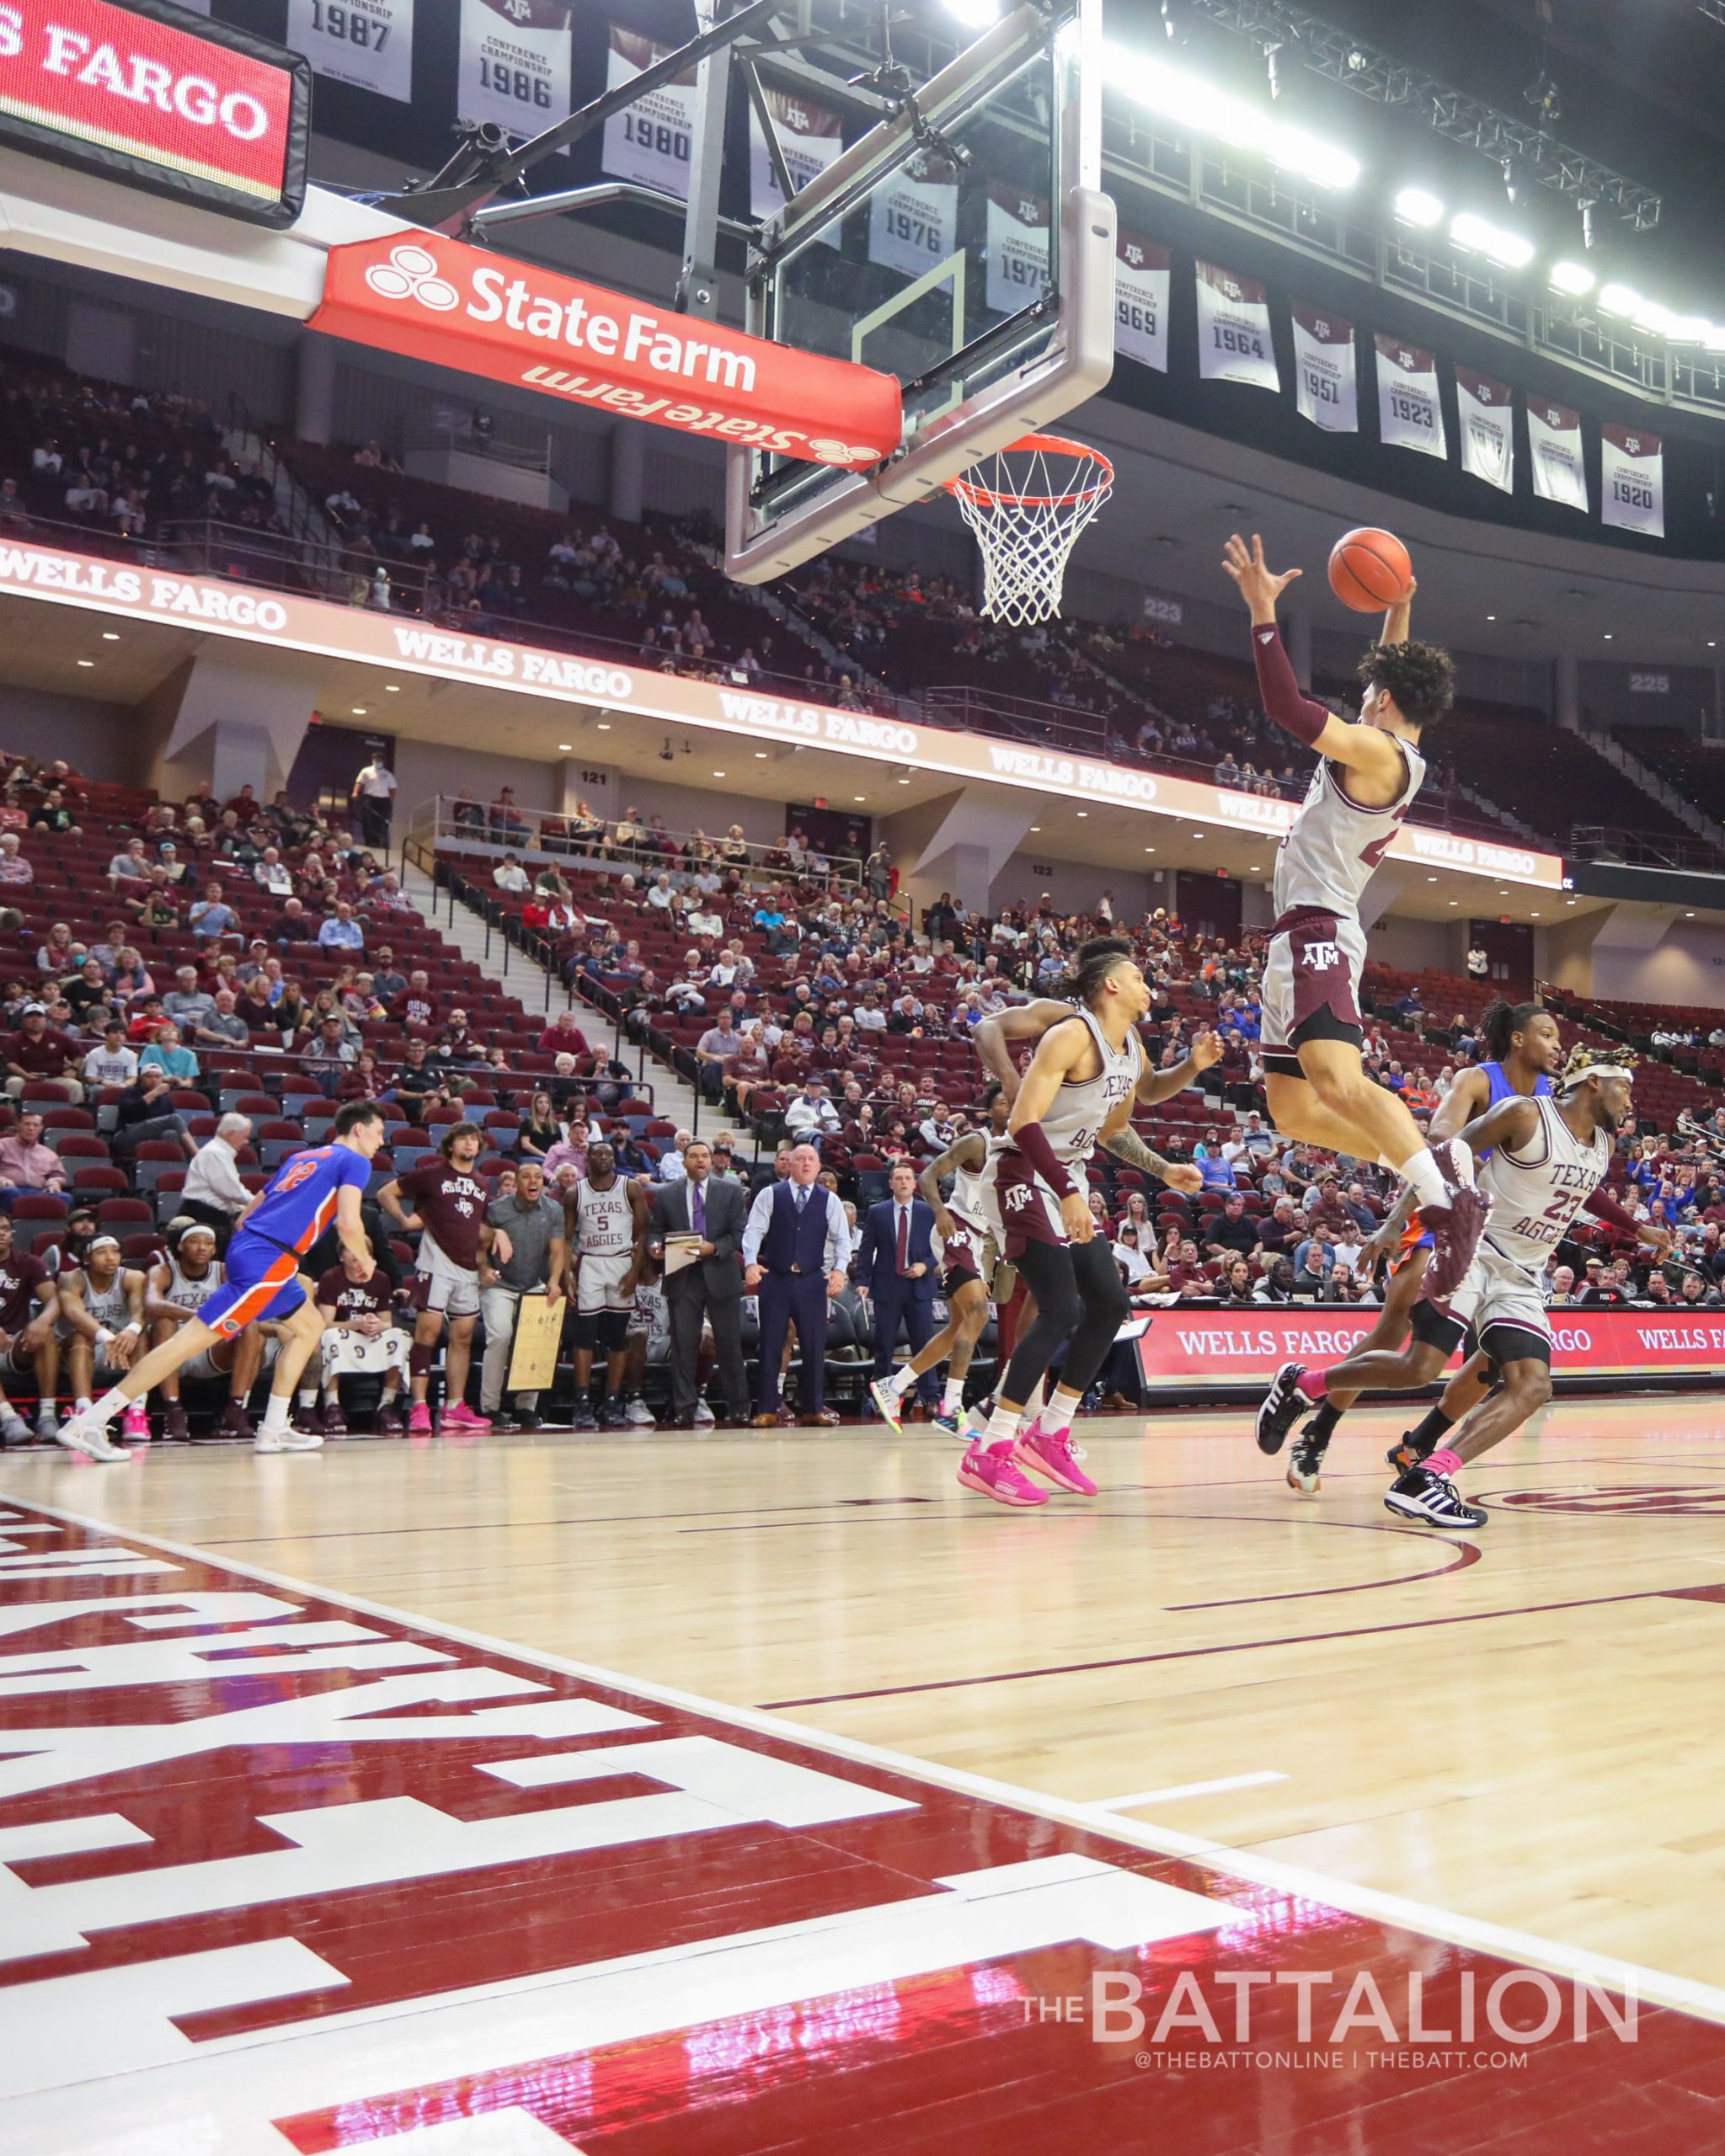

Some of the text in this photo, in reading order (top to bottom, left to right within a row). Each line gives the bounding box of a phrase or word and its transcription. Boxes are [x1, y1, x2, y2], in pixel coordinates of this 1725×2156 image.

[312, 0, 391, 52] 1987
[481, 44, 553, 76] CHAMPIONSHIP
[487, 35, 547, 65] CONFERENCE
[41, 23, 268, 141] FARGO
[480, 56, 553, 109] 1986
[625, 113, 689, 162] 1980
[887, 208, 941, 253] 1976
[1115, 300, 1156, 336] 969
[1214, 326, 1264, 360] 1964
[1303, 369, 1340, 404] 1951
[1391, 396, 1434, 428] 1923
[1613, 481, 1653, 510] 1920
[0, 548, 286, 630] WELLS FARGO
[1145, 597, 1181, 622] 223
[394, 628, 631, 698] WELLS FARGO
[1630, 675, 1669, 692] 225
[720, 692, 916, 753] WELLS FARGO
[580, 771, 606, 785] 121
[990, 746, 1156, 800] WELLS FARGO
[1218, 793, 1290, 825] WELLS
[1412, 832, 1535, 876] WELLS FARGO
[1033, 864, 1052, 877] 122
[275, 1161, 317, 1193] 12
[585, 1202, 622, 1217] TEXAS
[597, 1215, 609, 1230] 5
[1543, 1190, 1583, 1223] 23
[586, 1234, 622, 1247] AGGIES
[173, 1293, 211, 1306] TEXA
[633, 1309, 654, 1322] 35
[1176, 1331, 1278, 1355] WELLS
[1637, 1329, 1708, 1349] WELLS
